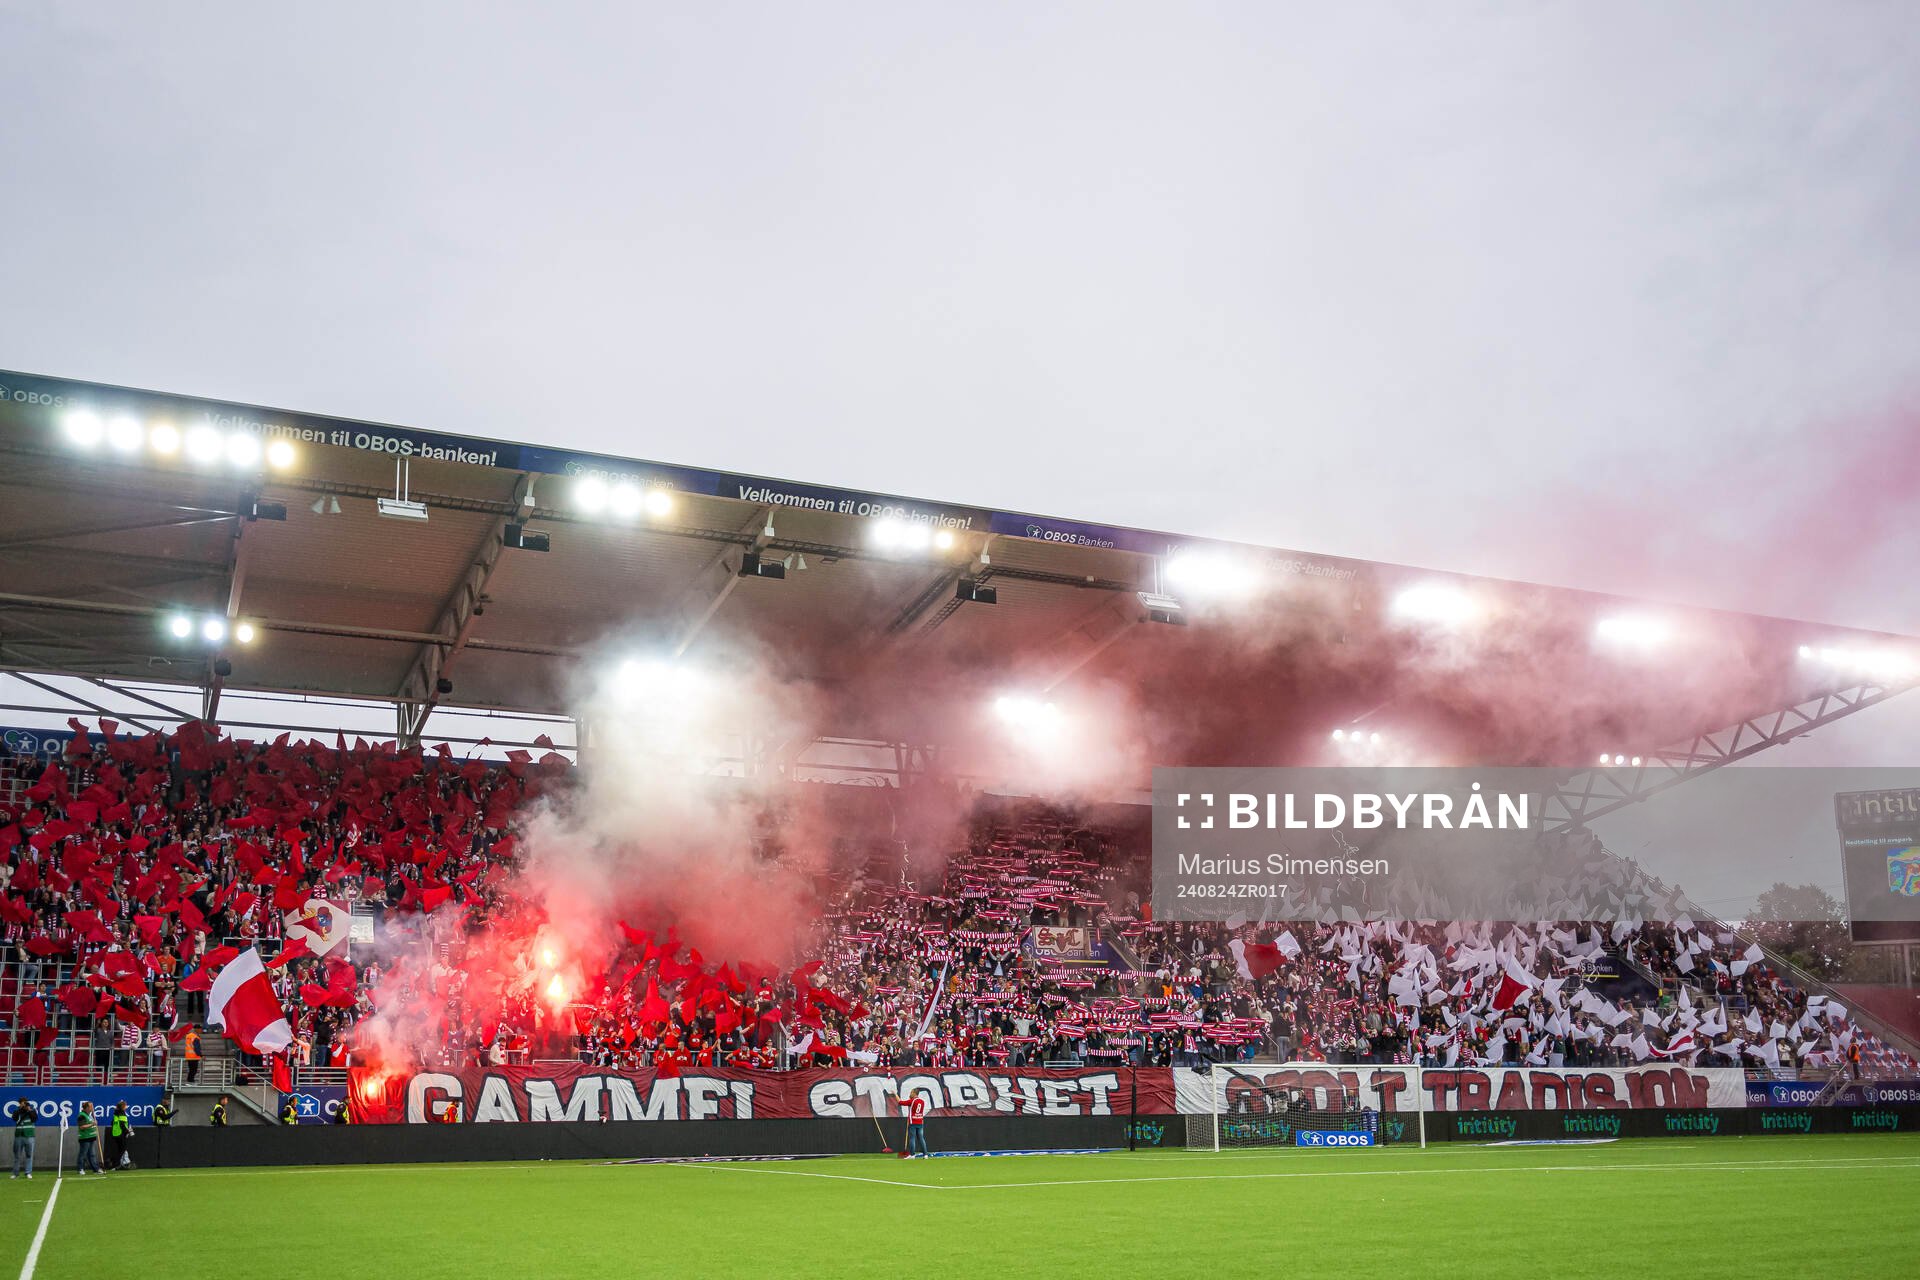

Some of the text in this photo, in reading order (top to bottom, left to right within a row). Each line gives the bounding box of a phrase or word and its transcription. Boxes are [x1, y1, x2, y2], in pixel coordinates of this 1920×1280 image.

[13, 390, 64, 409] OBOS
[203, 412, 498, 468] Velkommen til OBOS-banken!
[738, 485, 972, 530] Velkommen til OBOS-banken!
[1043, 530, 1115, 550] OBOS Banken
[1854, 792, 1920, 815] intil
[1879, 1089, 1908, 1101] OBOS
[3, 1100, 74, 1119] OOS
[1457, 1116, 1517, 1138] intility
[1664, 1113, 1720, 1134] intility
[1761, 1112, 1813, 1132] intility
[1851, 1111, 1900, 1131] intility
[1326, 1134, 1369, 1146] OBOS
